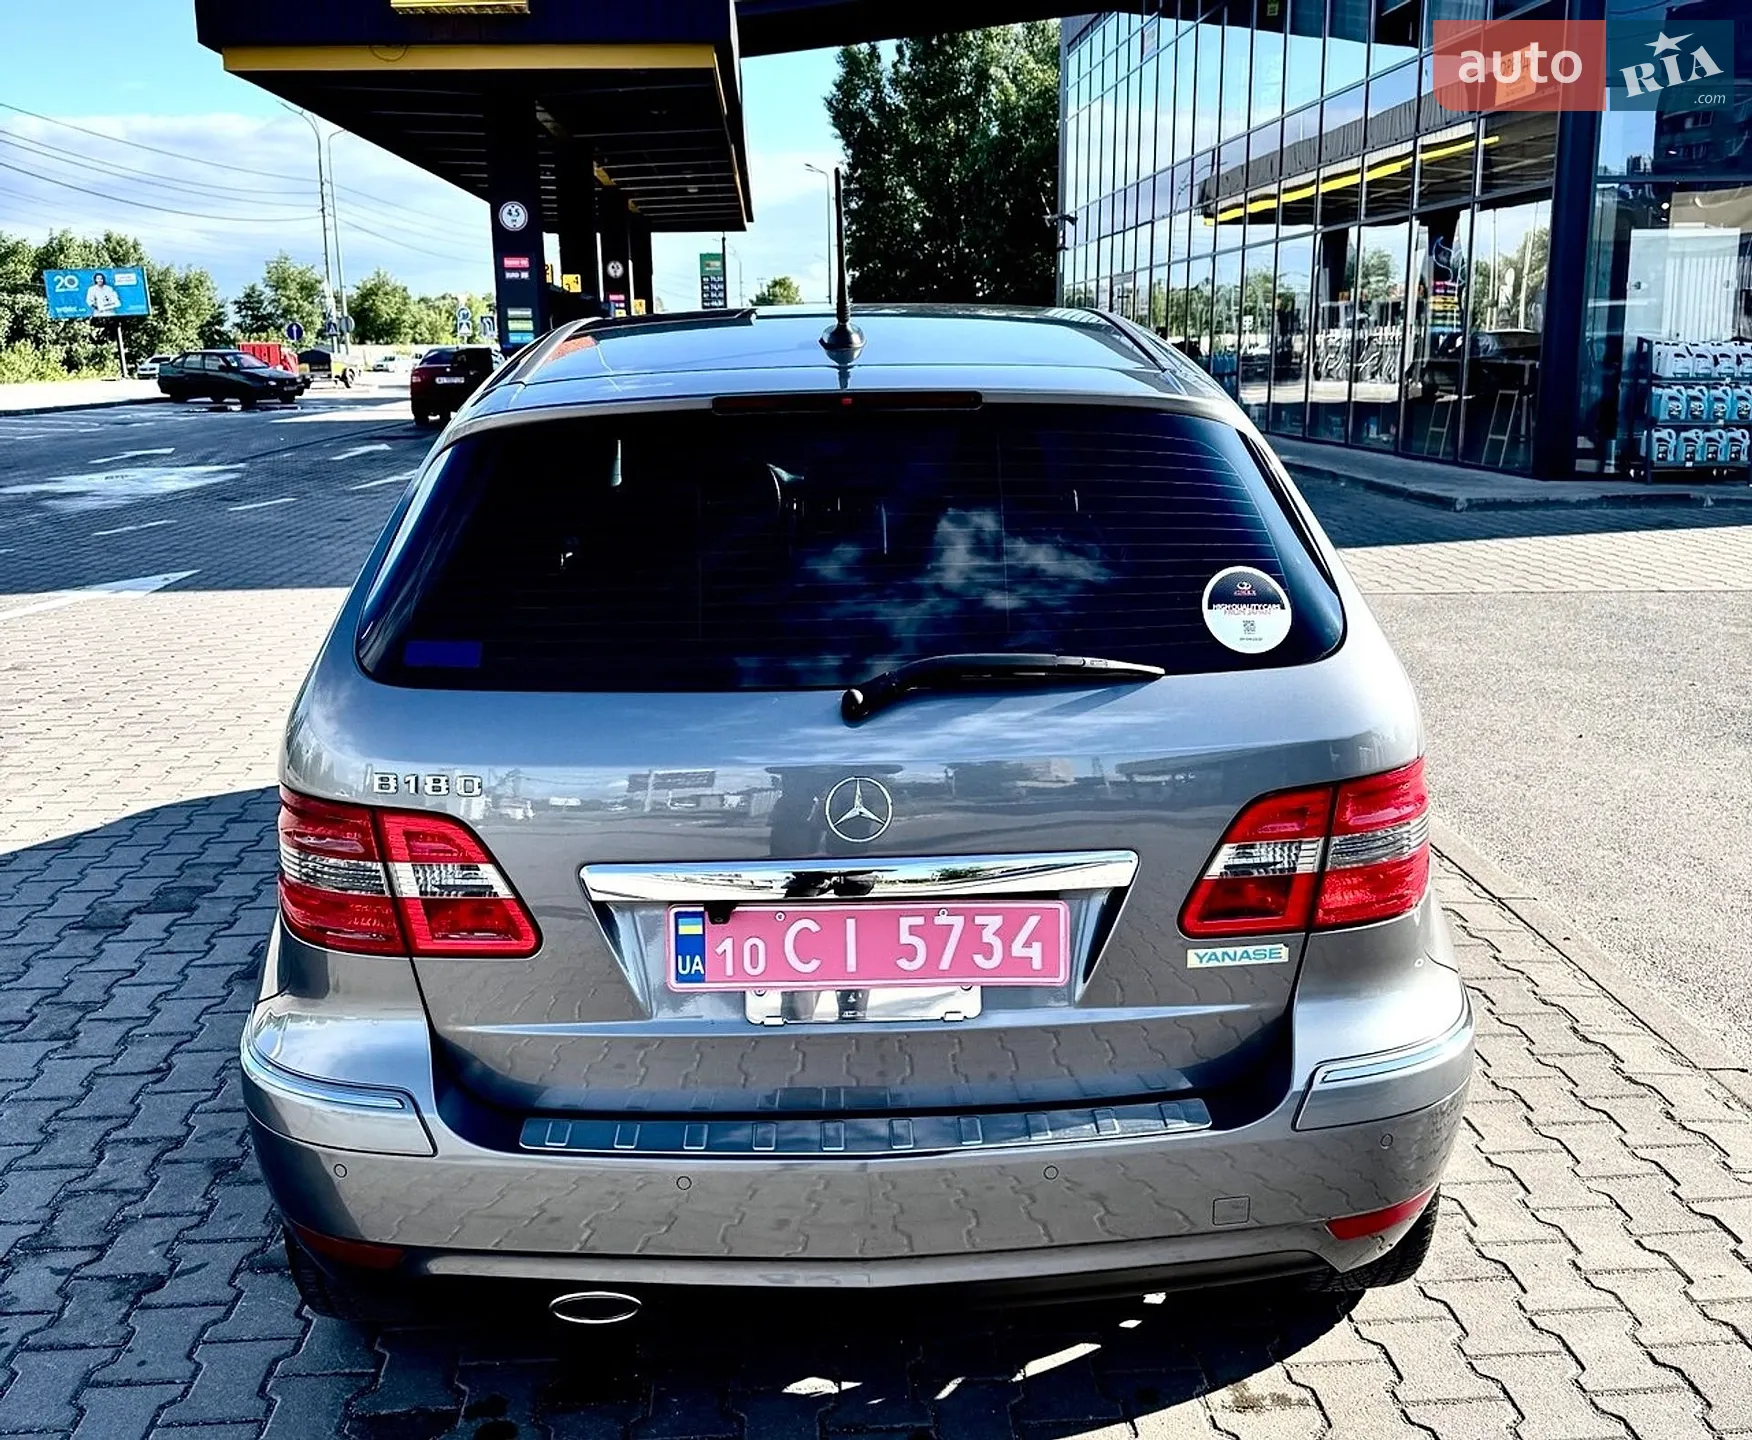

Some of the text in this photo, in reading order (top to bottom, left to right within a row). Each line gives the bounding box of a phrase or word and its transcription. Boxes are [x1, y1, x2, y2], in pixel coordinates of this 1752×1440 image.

[373, 772, 482, 797] B180
[714, 914, 1043, 977] 10 CI 5734
[1194, 947, 1283, 964] YANASE
[677, 955, 705, 975] UA
